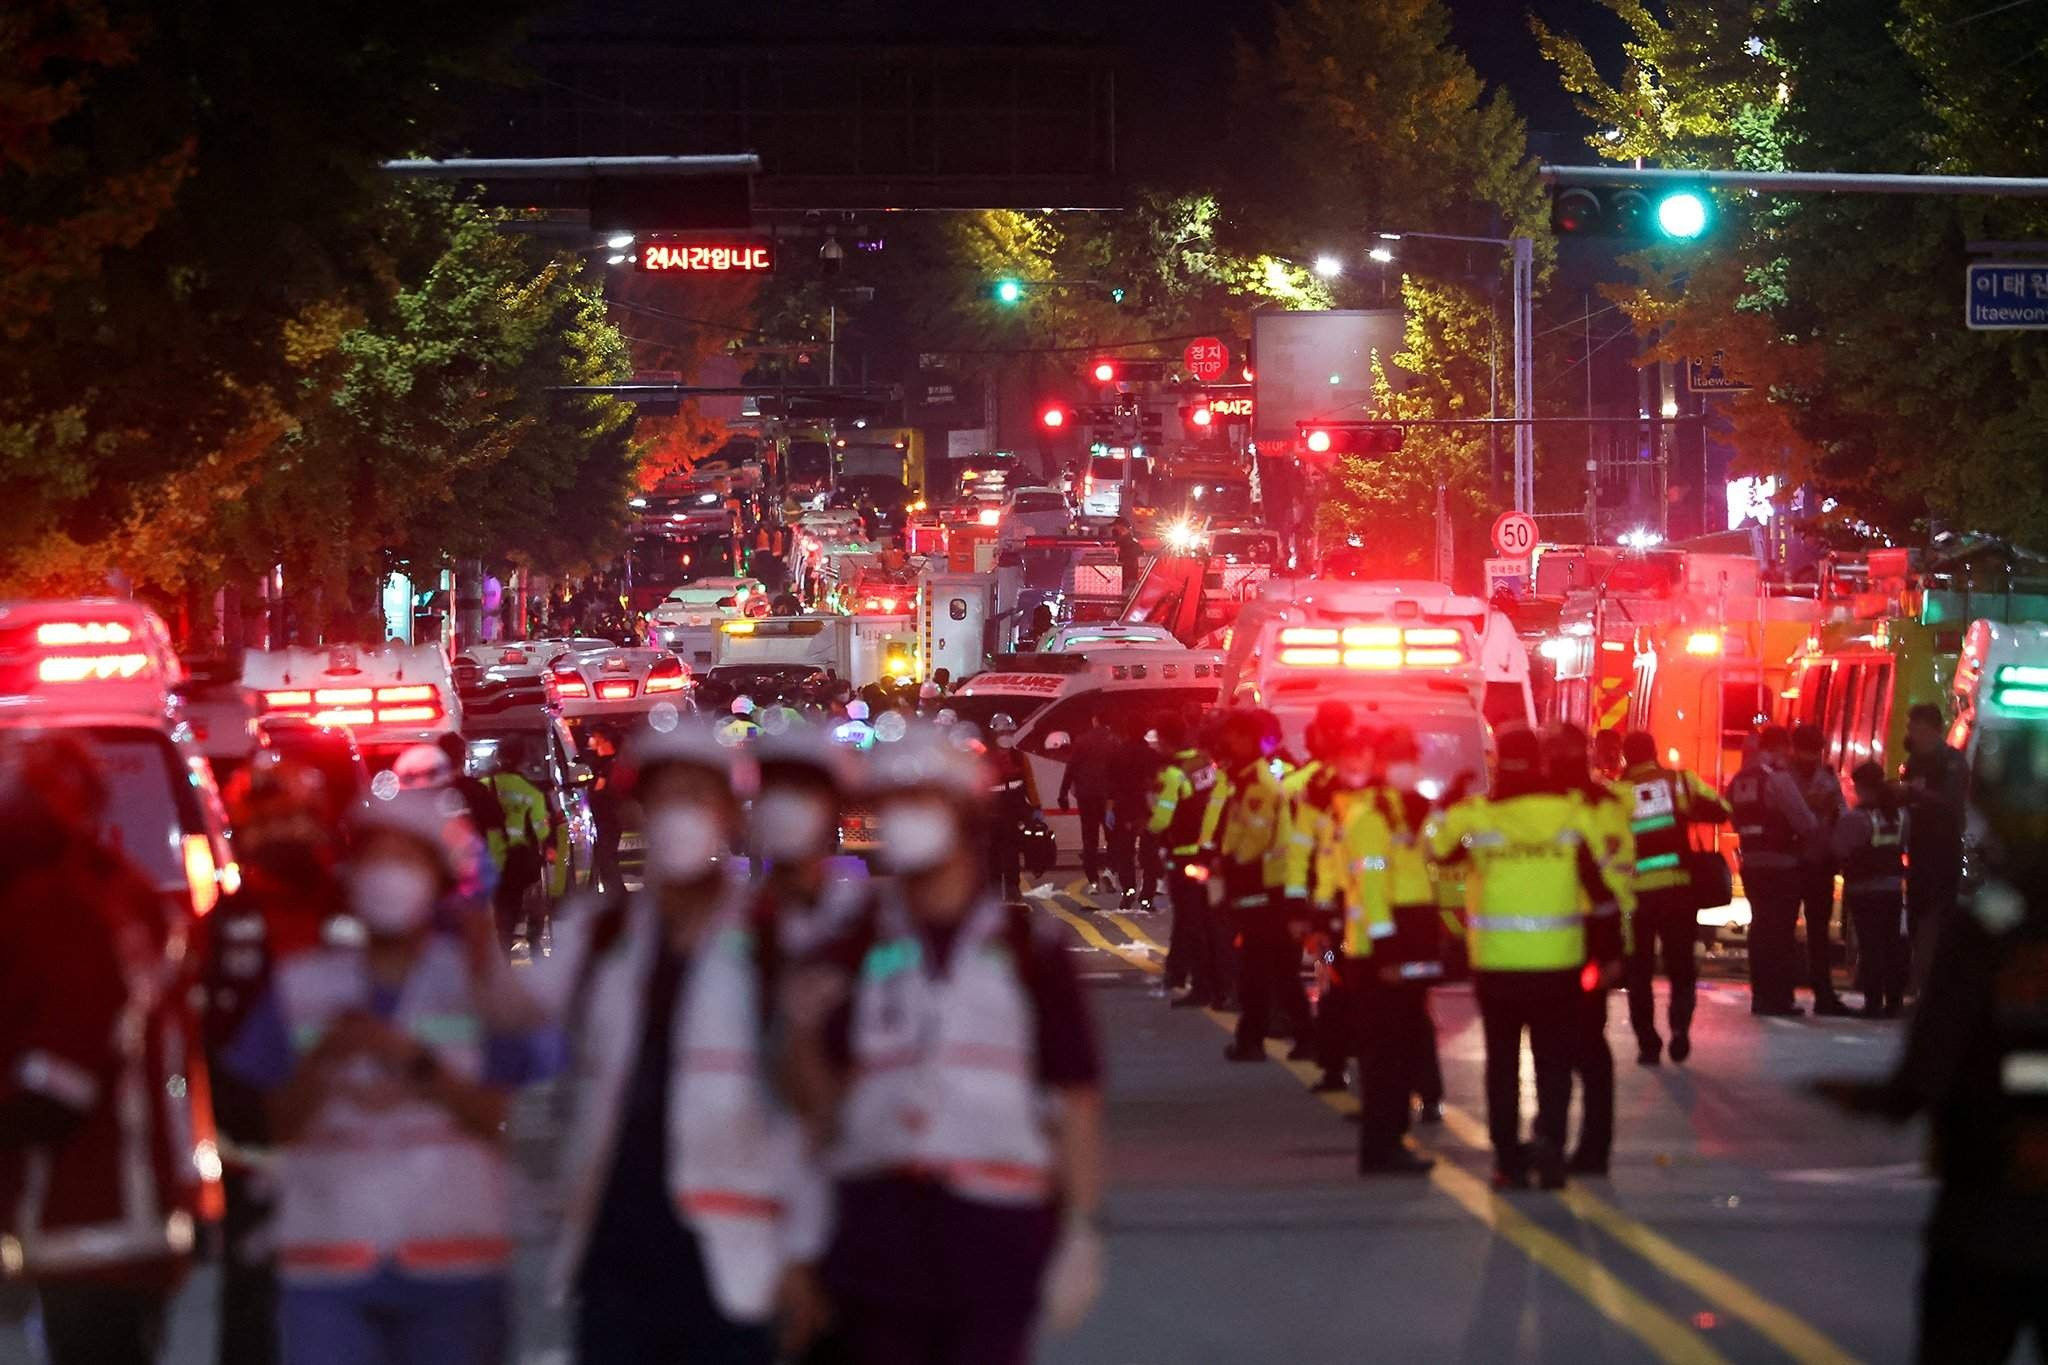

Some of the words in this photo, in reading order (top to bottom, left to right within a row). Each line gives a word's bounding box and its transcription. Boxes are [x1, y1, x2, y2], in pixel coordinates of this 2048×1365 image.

[1192, 345, 1221, 360] 정지
[1191, 361, 1221, 373] STOP
[1504, 524, 1528, 547] 50
